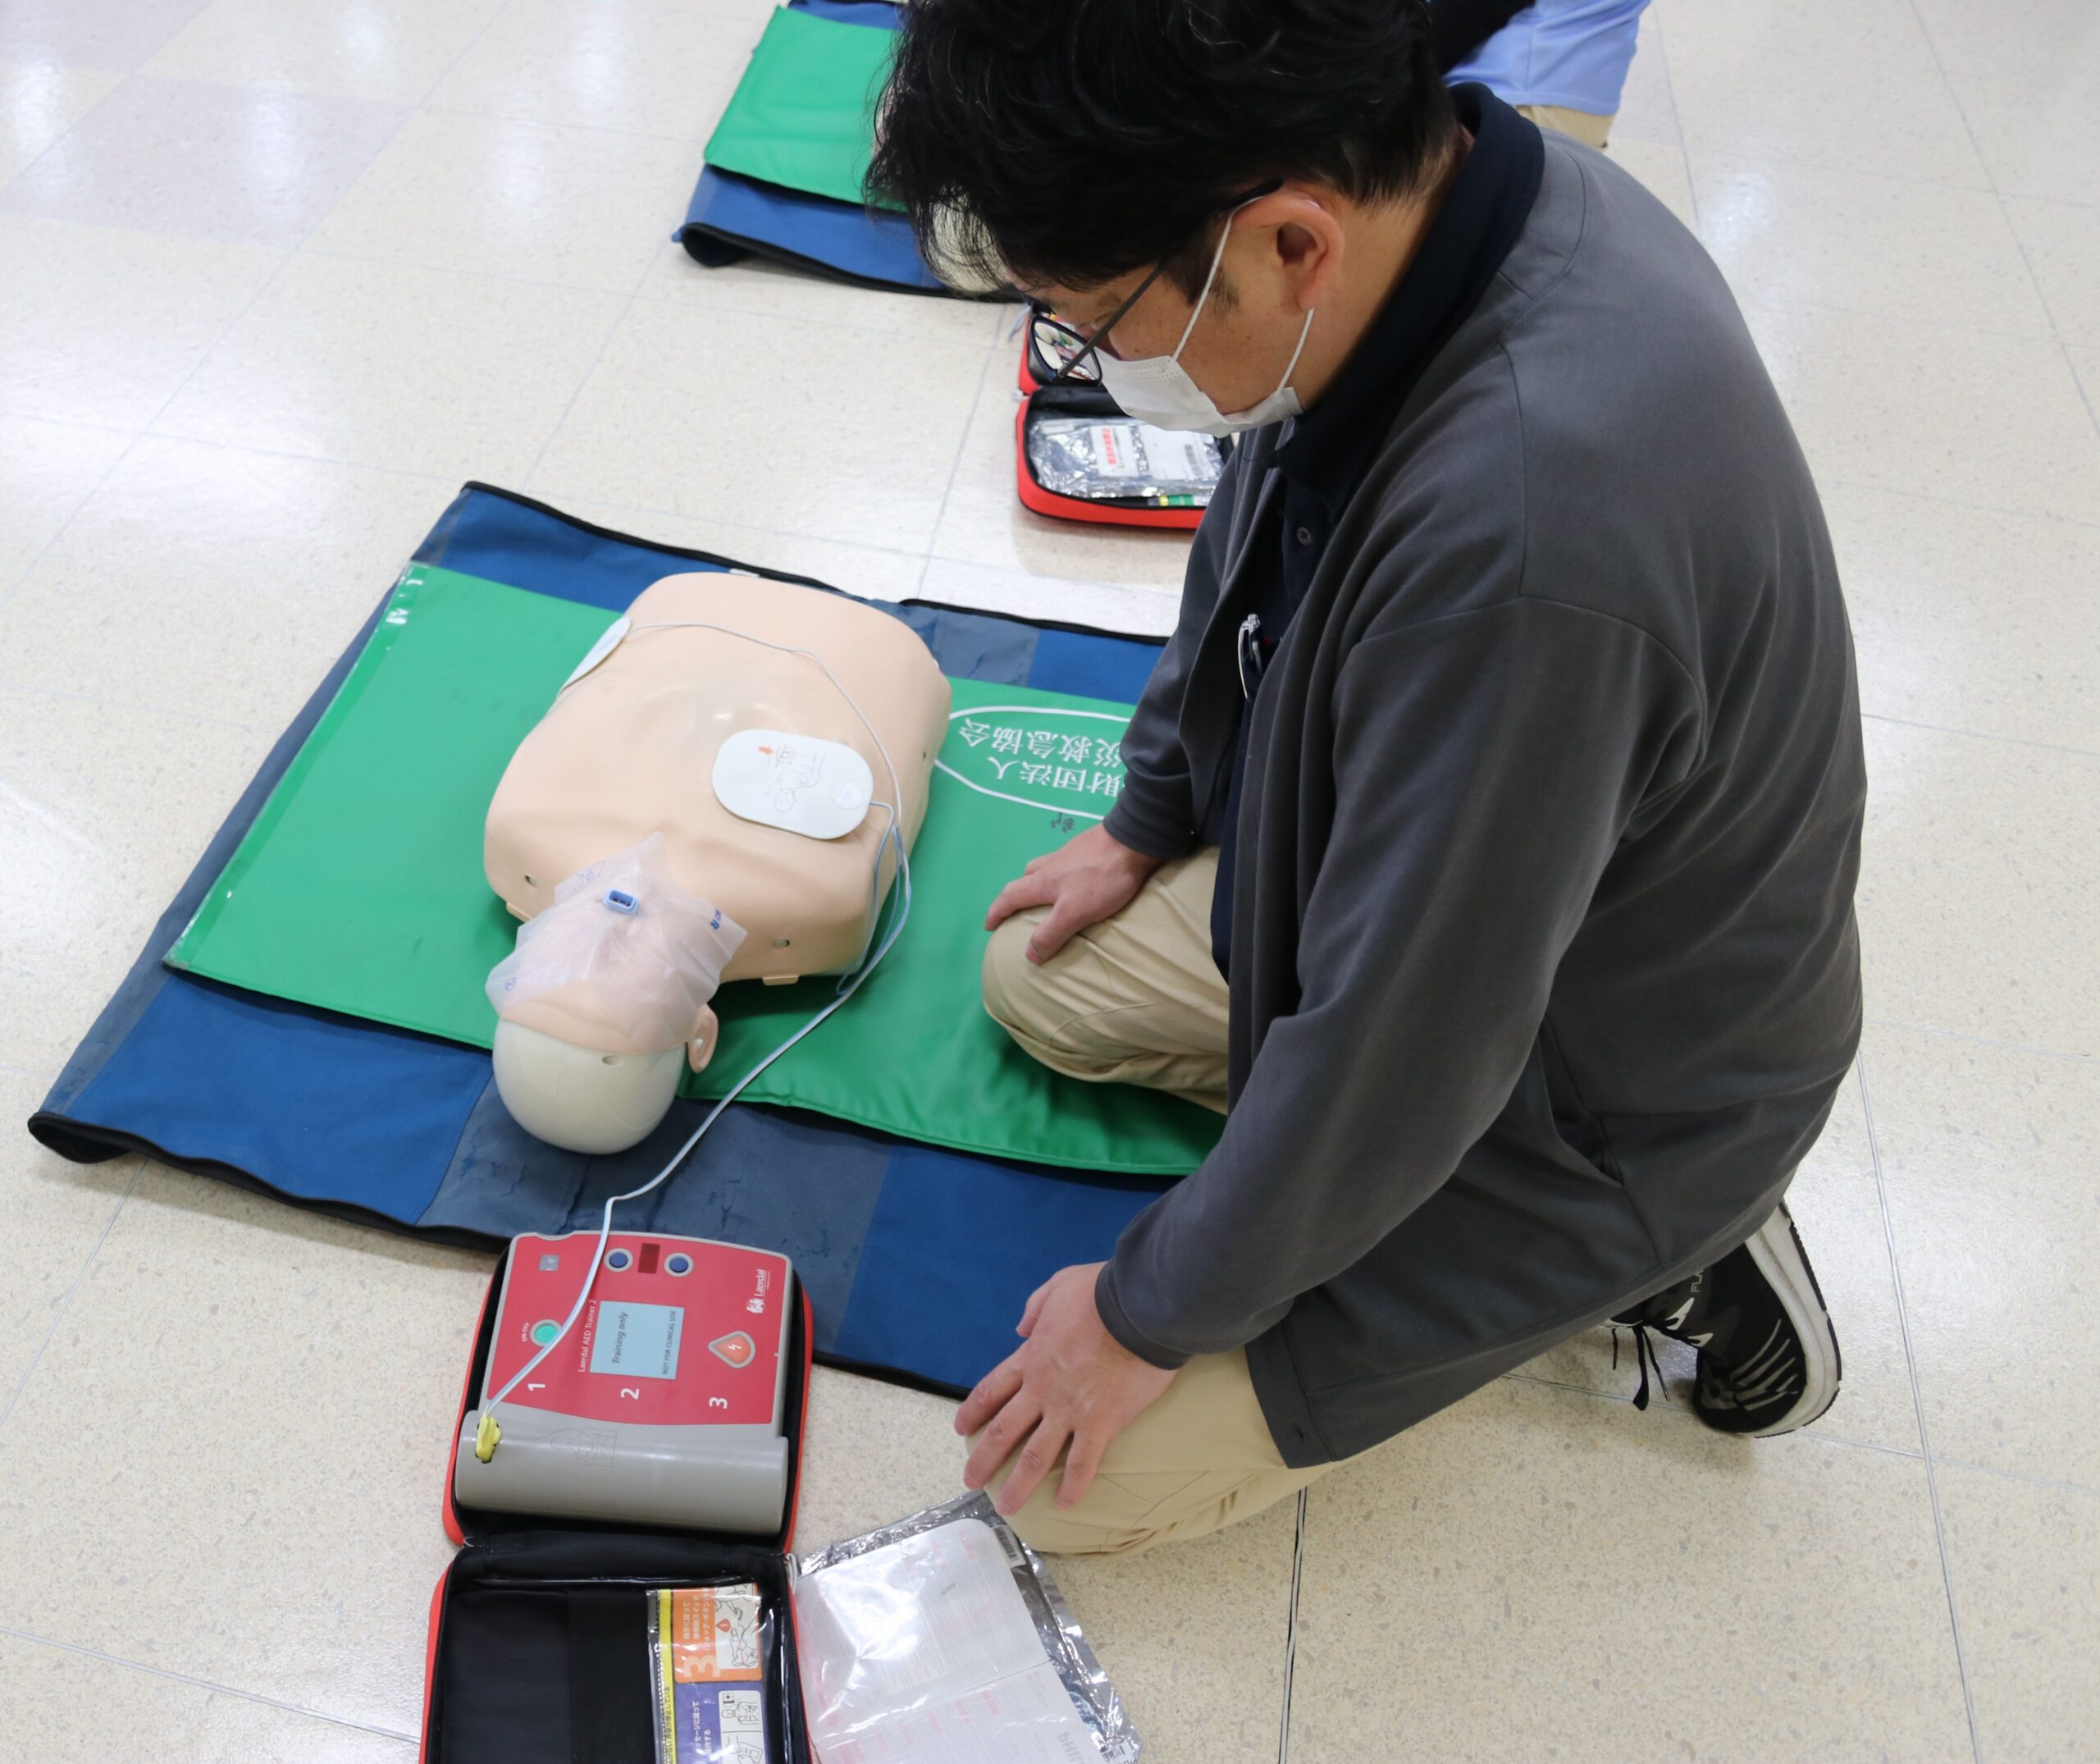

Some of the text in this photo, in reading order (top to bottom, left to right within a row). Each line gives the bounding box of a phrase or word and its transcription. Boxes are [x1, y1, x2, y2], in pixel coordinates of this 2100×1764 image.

[988, 756, 1122, 798] 財団法人
[584, 1305, 596, 1329] Trainer
[582, 1330, 591, 1346] AED
[612, 1311, 629, 1364] Training only
[665, 1323, 675, 1349] CLINICAL
[578, 1346, 589, 1373] Laerdal
[664, 1349, 672, 1361] FOR
[662, 1361, 670, 1375] NOT
[527, 1382, 546, 1392] 1
[620, 1387, 640, 1400] 2
[709, 1396, 728, 1409] 3
[682, 1654, 721, 1678] 3
